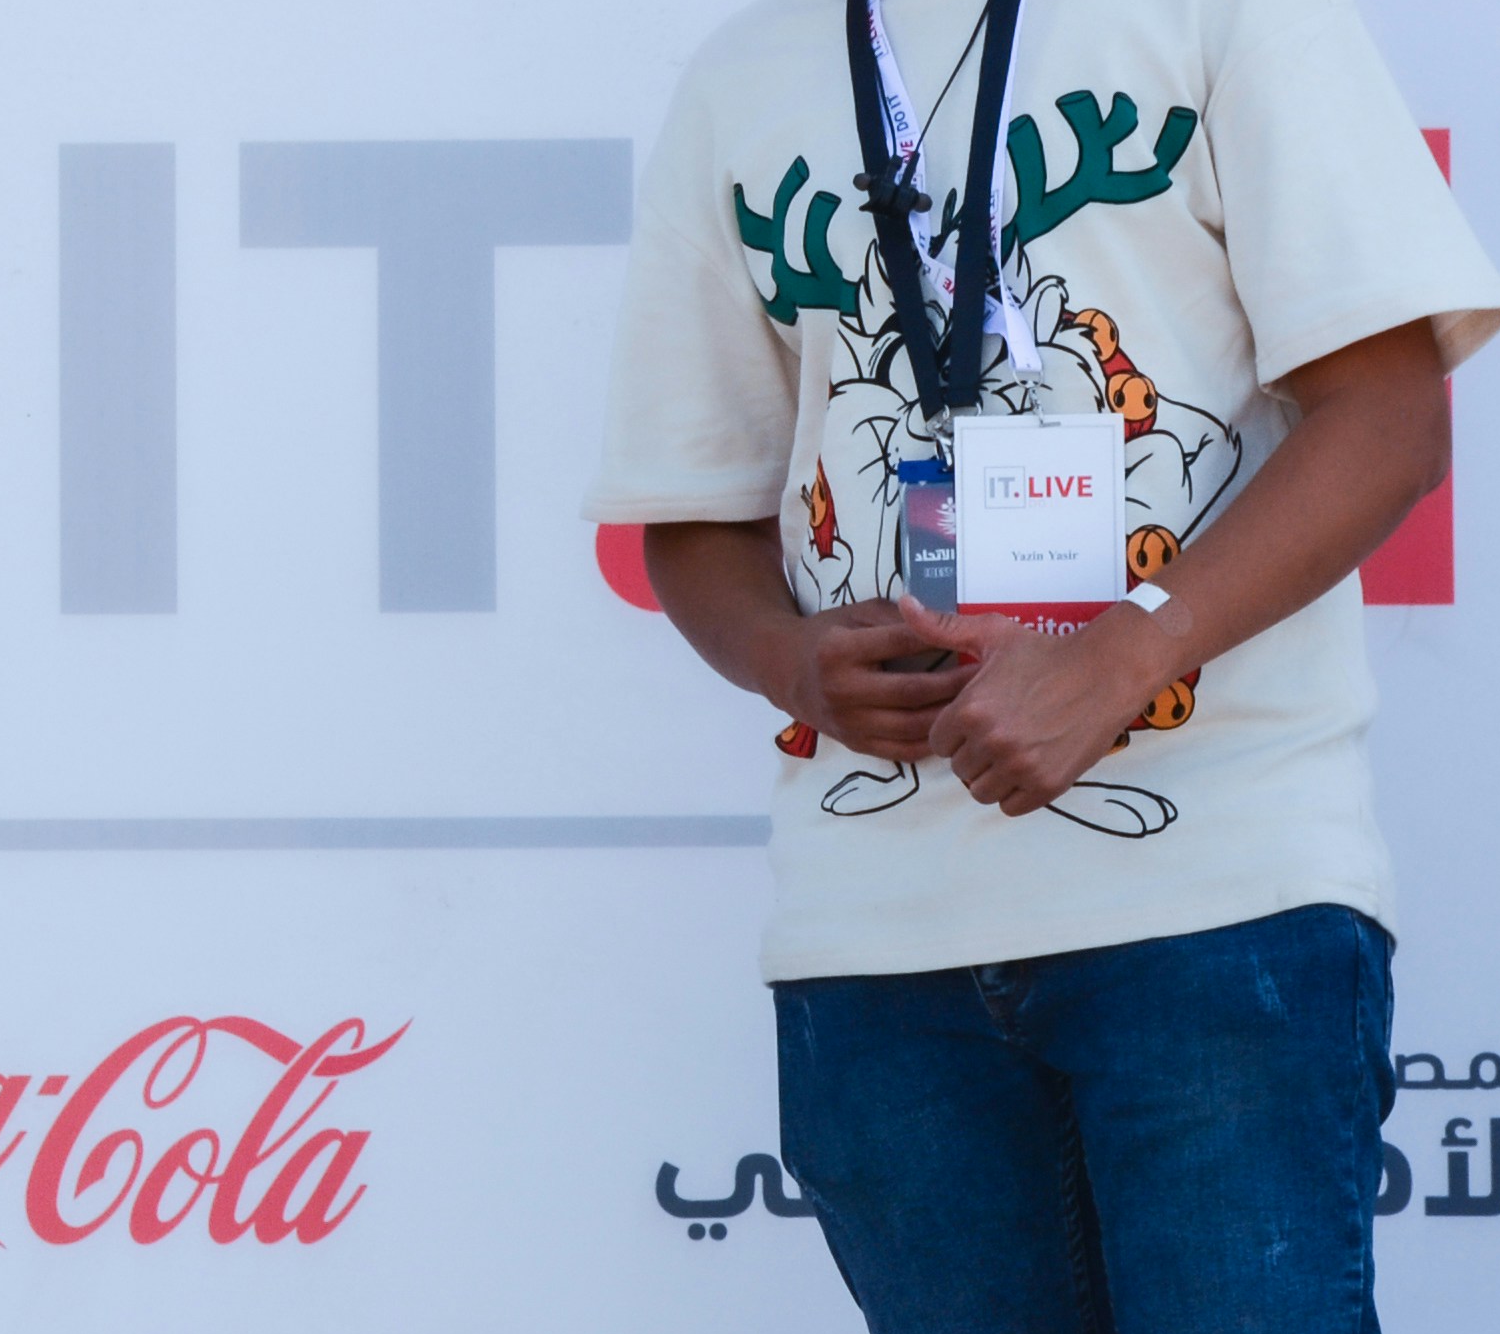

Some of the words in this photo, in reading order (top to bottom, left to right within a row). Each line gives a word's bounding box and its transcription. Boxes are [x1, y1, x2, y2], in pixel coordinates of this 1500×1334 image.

[887, 93, 901, 109] IT
[894, 110, 909, 131] DO
[1028, 475, 1093, 498] LIVE
[1011, 550, 1044, 562] Yazin
[1048, 549, 1079, 562] Yasir
